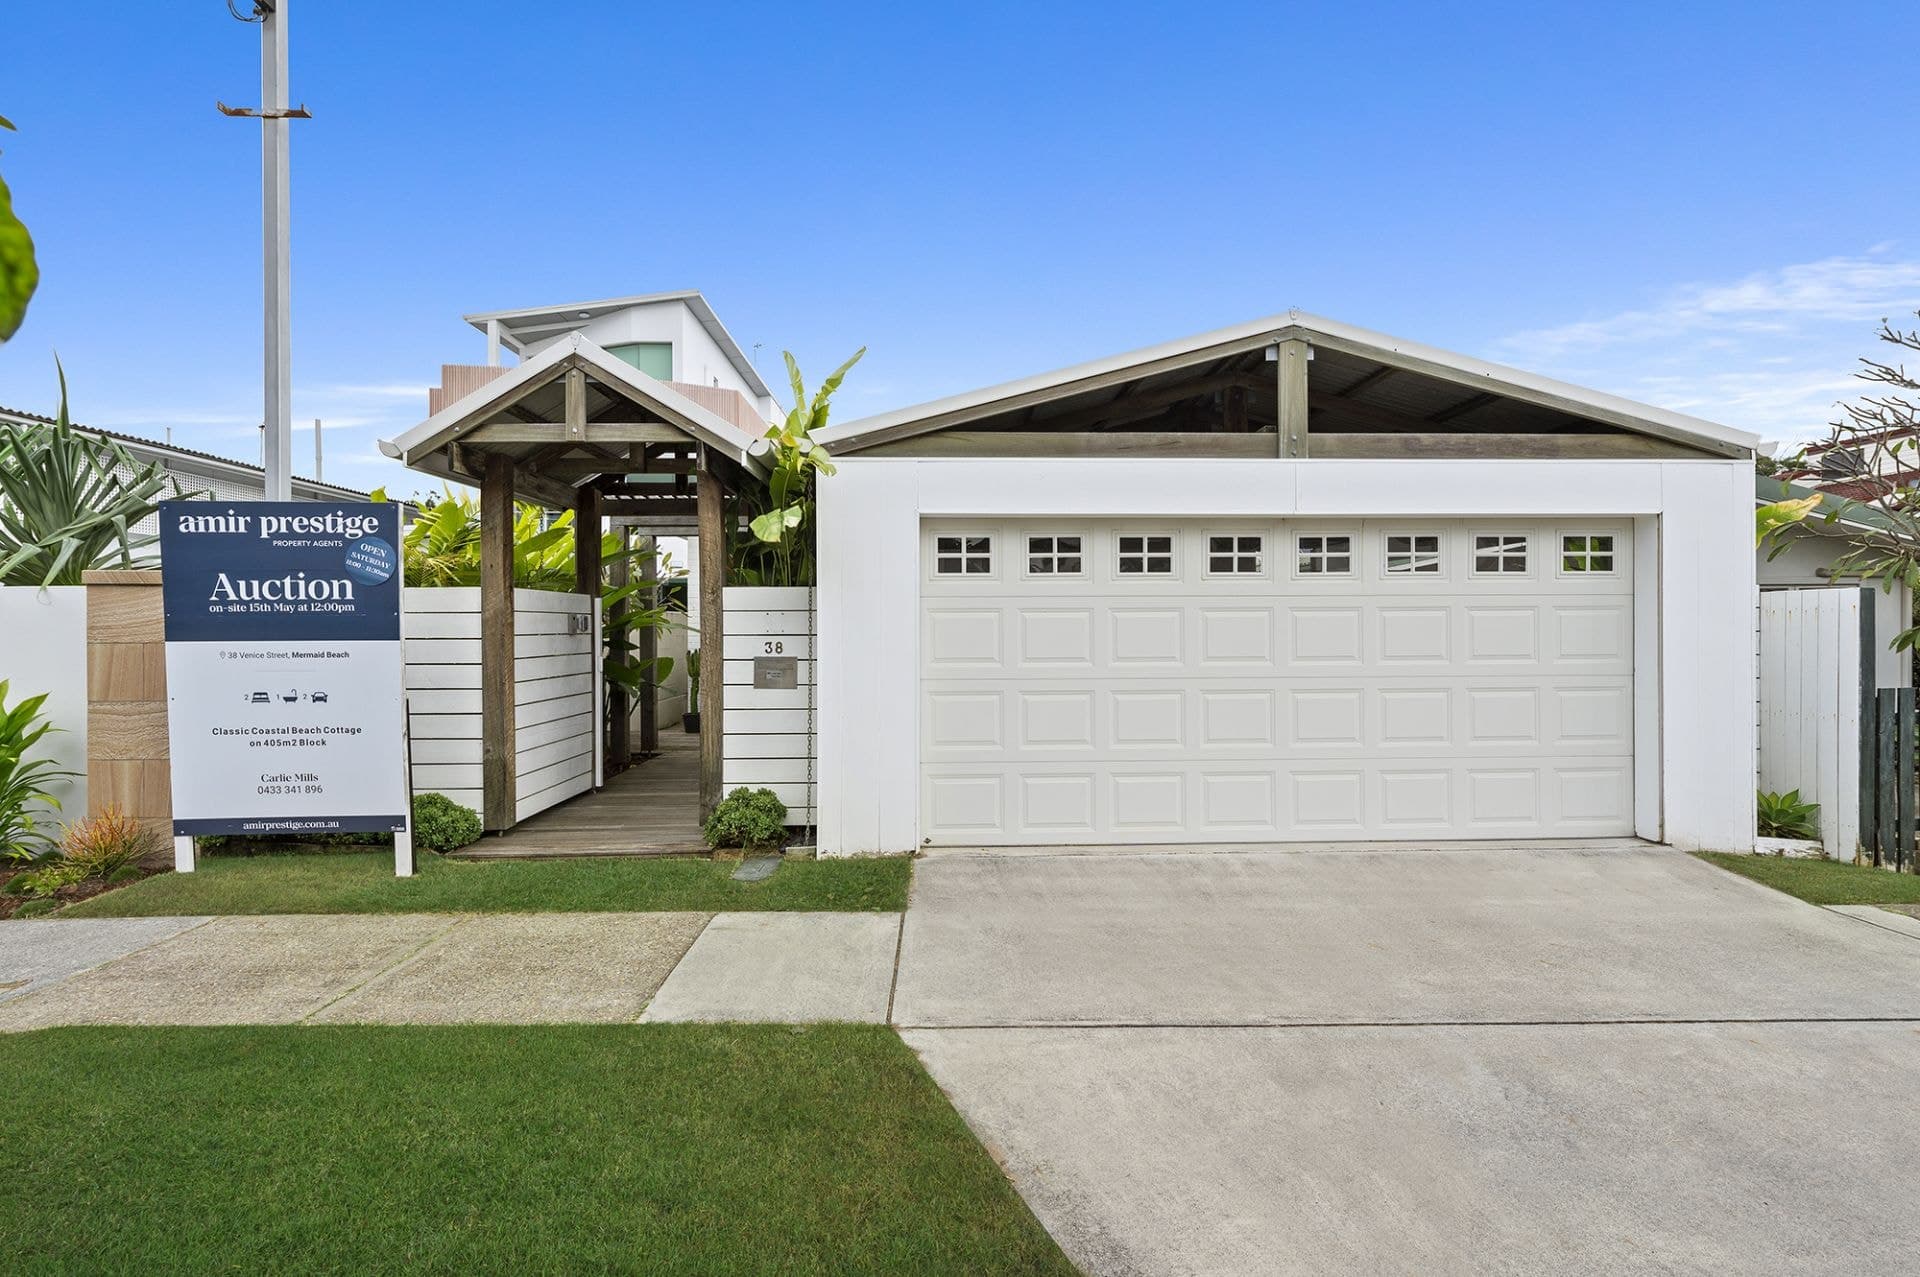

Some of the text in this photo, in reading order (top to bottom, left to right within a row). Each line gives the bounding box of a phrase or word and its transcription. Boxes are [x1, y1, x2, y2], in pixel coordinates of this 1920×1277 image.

[179, 509, 379, 538] amir prestige
[360, 543, 387, 557] OPEN
[351, 552, 390, 568] SATURDAY
[209, 571, 355, 601] Auction
[209, 602, 355, 613] on-site 15th May at 12:00pm
[764, 642, 783, 654] 38
[266, 652, 290, 660] Street,
[212, 726, 362, 736] Classic Coastal Beach Cottage
[300, 738, 327, 746] Block
[261, 773, 319, 782] Carlie Mills
[258, 785, 323, 794] 0433 341 896
[243, 820, 340, 830] amirprestige.com.au
